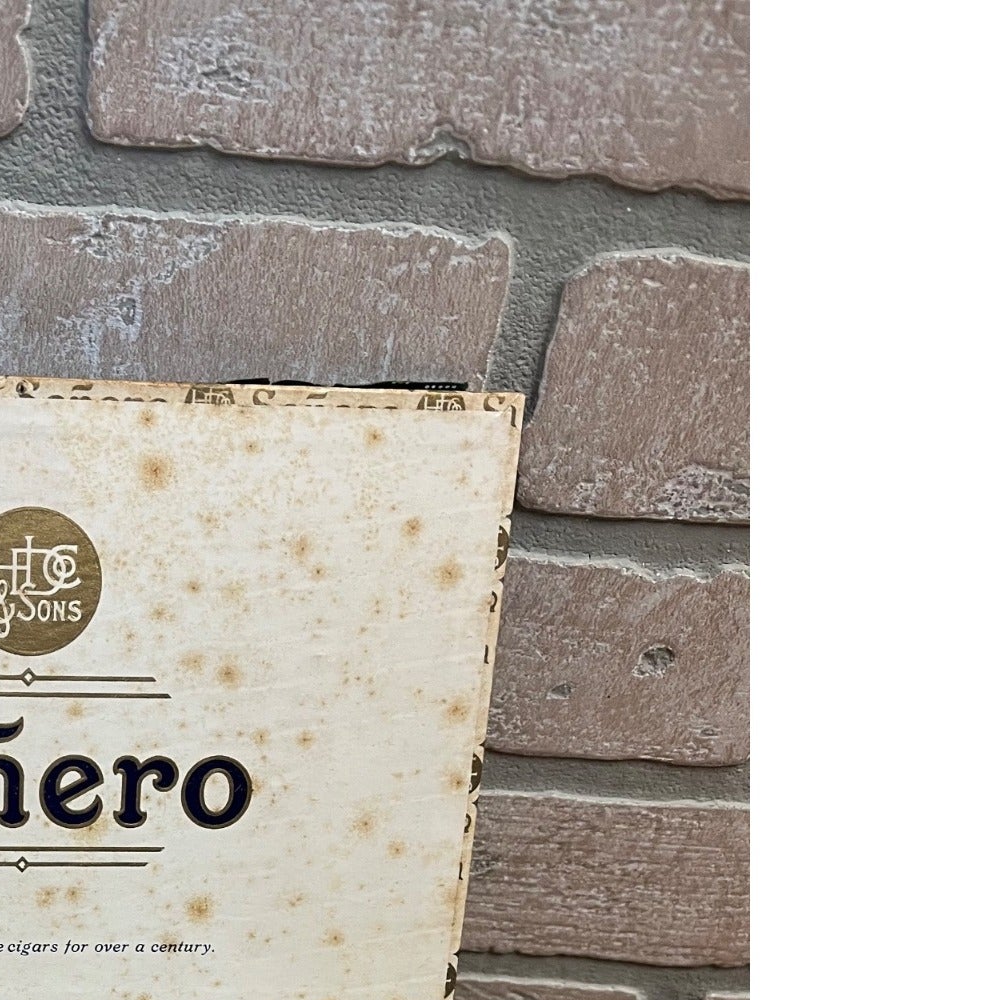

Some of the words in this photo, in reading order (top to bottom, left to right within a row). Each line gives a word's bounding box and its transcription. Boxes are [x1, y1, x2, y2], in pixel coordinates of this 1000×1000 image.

[7, 940, 58, 956] cigars
[63, 939, 89, 954] for
[94, 943, 130, 954] over
[135, 944, 145, 954] a
[150, 941, 215, 956] century.
